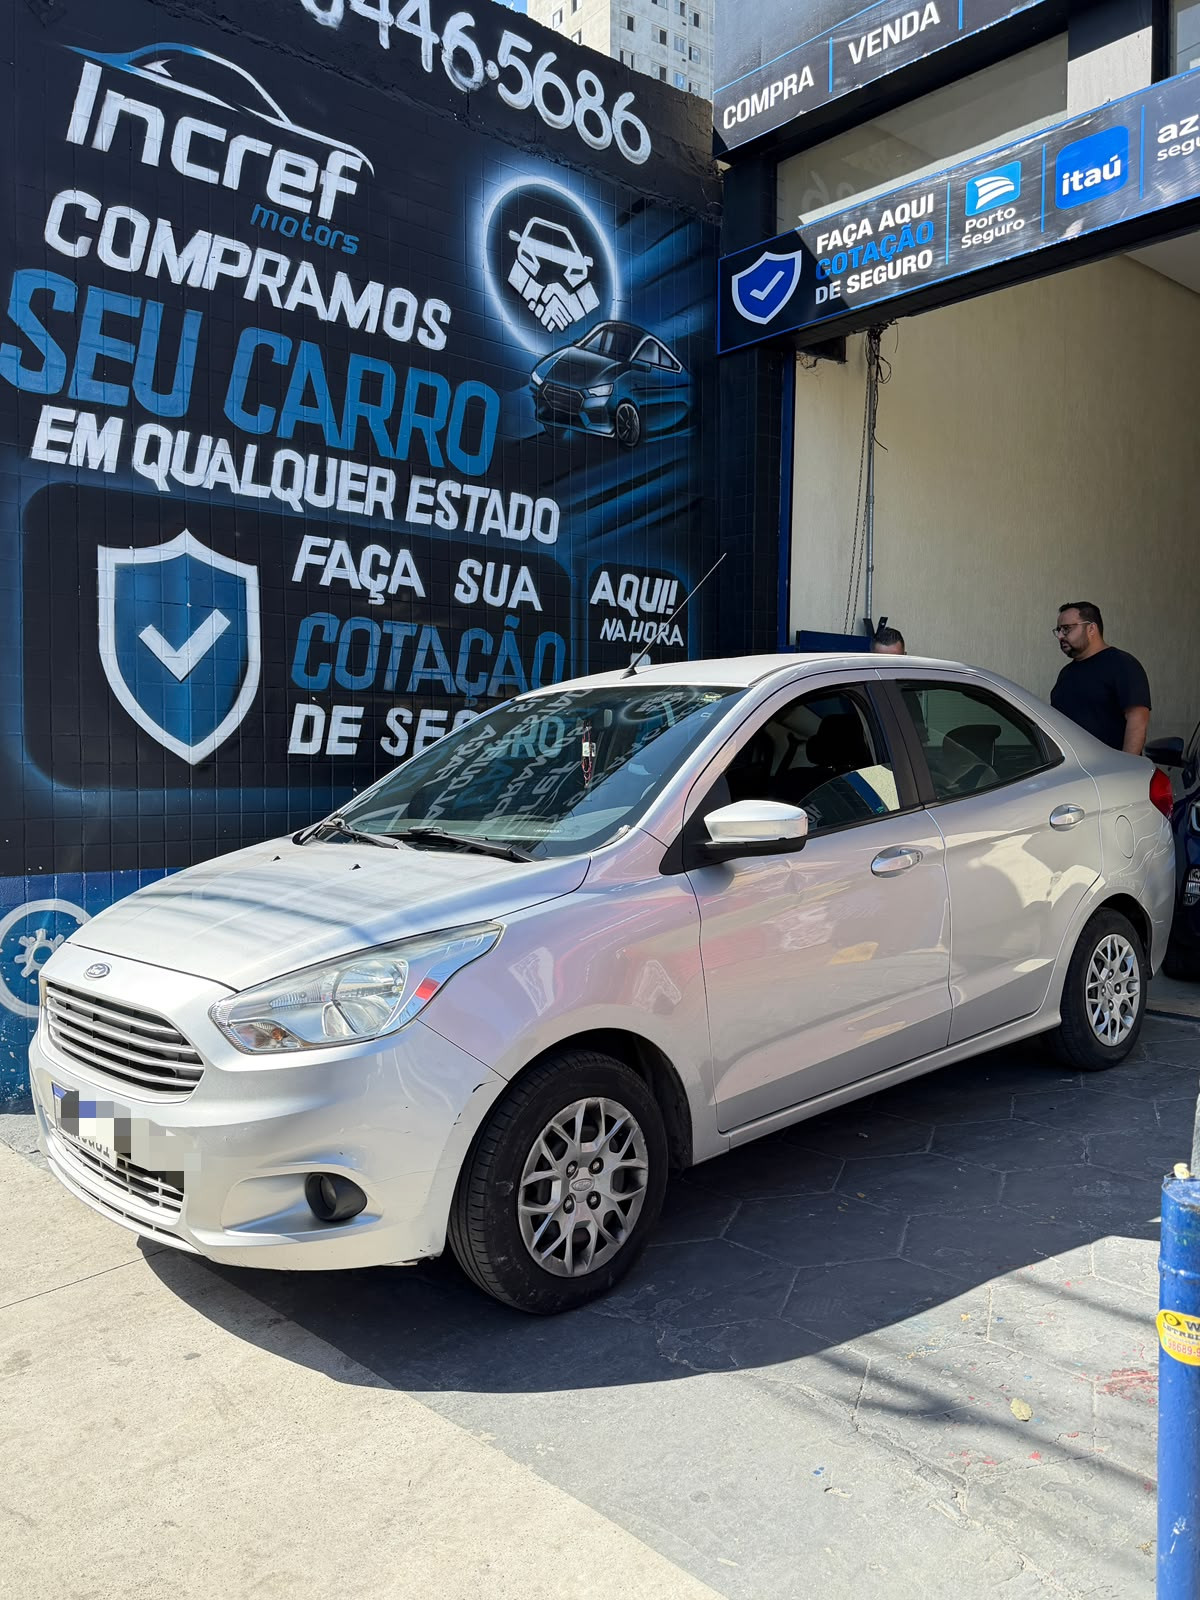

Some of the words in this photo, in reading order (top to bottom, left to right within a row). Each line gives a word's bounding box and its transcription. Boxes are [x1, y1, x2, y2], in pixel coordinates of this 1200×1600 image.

[848, 1, 941, 65] VENDA
[722, 65, 815, 130] COMPRA
[65, 61, 362, 222] Incref
[1061, 154, 1122, 196] itaú
[250, 203, 360, 255] motors
[815, 220, 934, 281] COTAÇÃO
[816, 217, 873, 254] FAÇA
[877, 193, 934, 233] AQUI
[961, 217, 1025, 249] Seguro
[965, 207, 1016, 233] Porto
[44, 189, 452, 351] COMPRAMOS
[815, 280, 841, 305] DE
[846, 249, 933, 294] SEGURO
[0, 268, 203, 418] SEU
[224, 327, 501, 477] CARRO
[31, 404, 124, 474] EM
[132, 422, 397, 520] QUALQUER
[406, 474, 561, 545] ESTADO
[292, 535, 426, 605] FAÇA
[454, 558, 543, 612] SUA
[291, 611, 567, 707] COTAÇÃO
[600, 617, 627, 641] NA
[628, 619, 684, 647] HORA
[287, 702, 365, 756] DE
